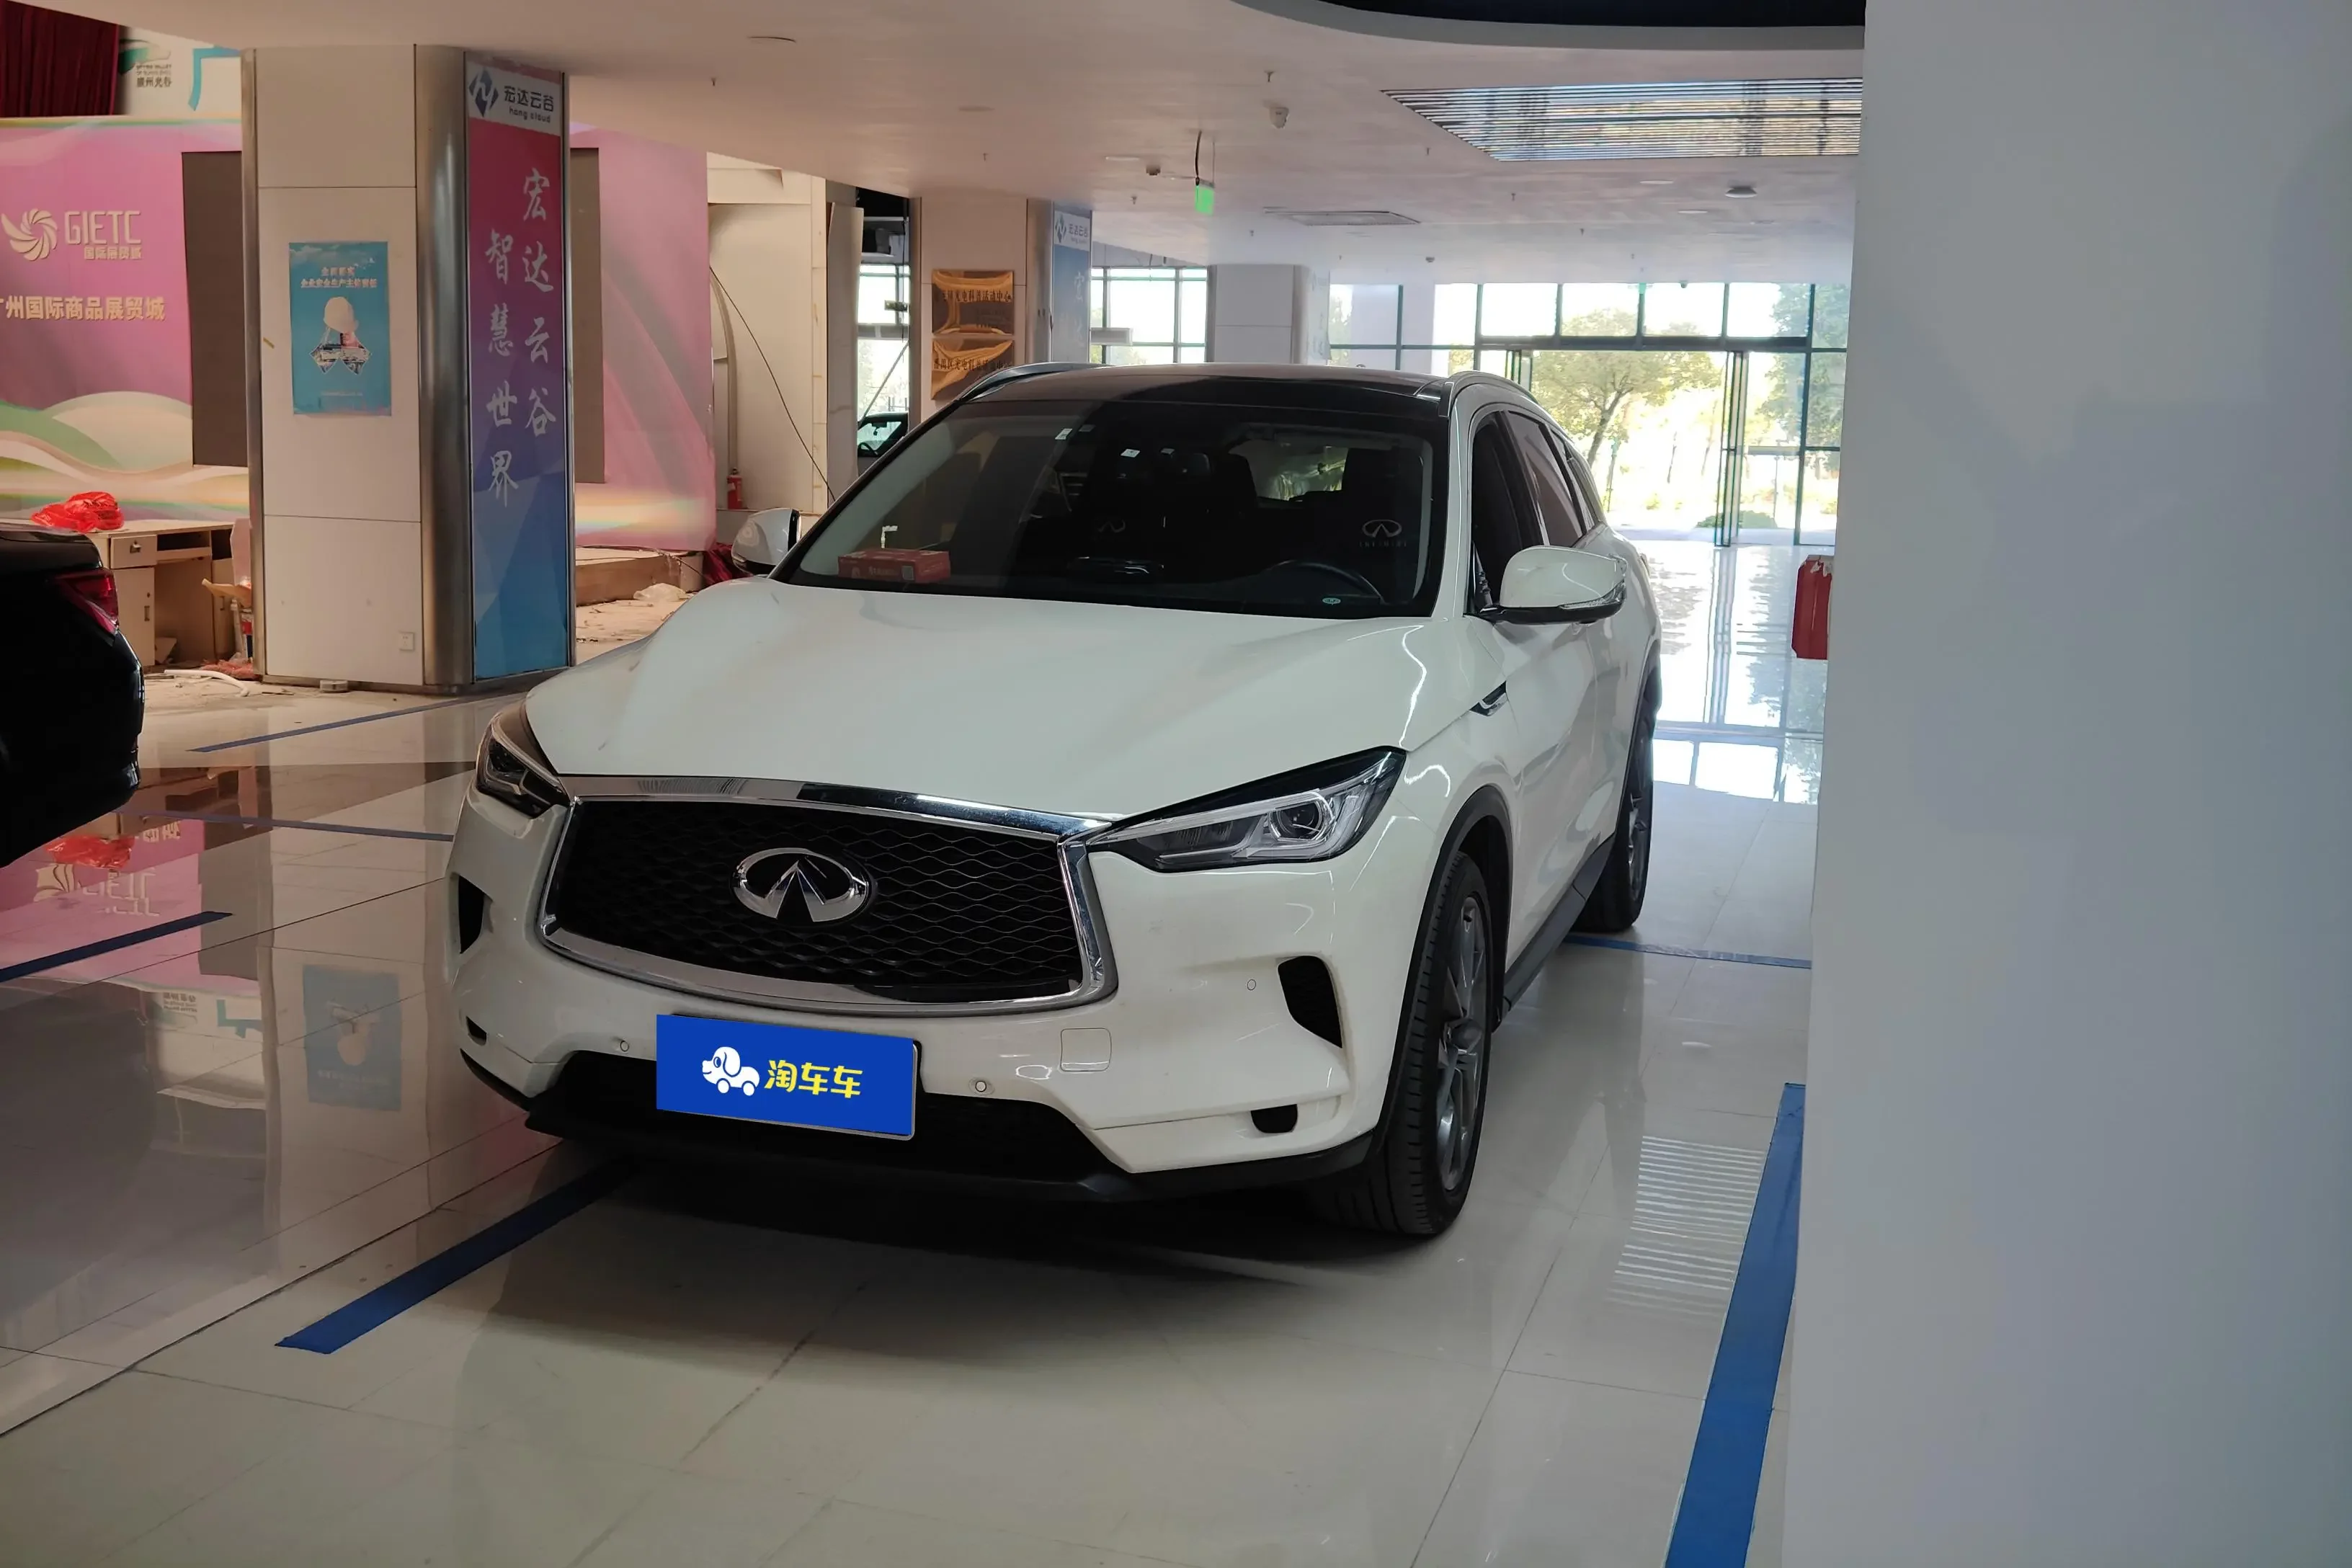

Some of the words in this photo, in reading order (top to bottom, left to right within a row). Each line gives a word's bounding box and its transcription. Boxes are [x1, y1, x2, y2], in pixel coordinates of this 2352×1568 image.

[504, 85, 554, 112] 宏达云谷
[64, 210, 141, 244] GIETC
[0, 295, 165, 320] 州国际商品展贸城
[522, 167, 556, 437] 宏达云谷
[485, 228, 519, 507] 智慧世界
